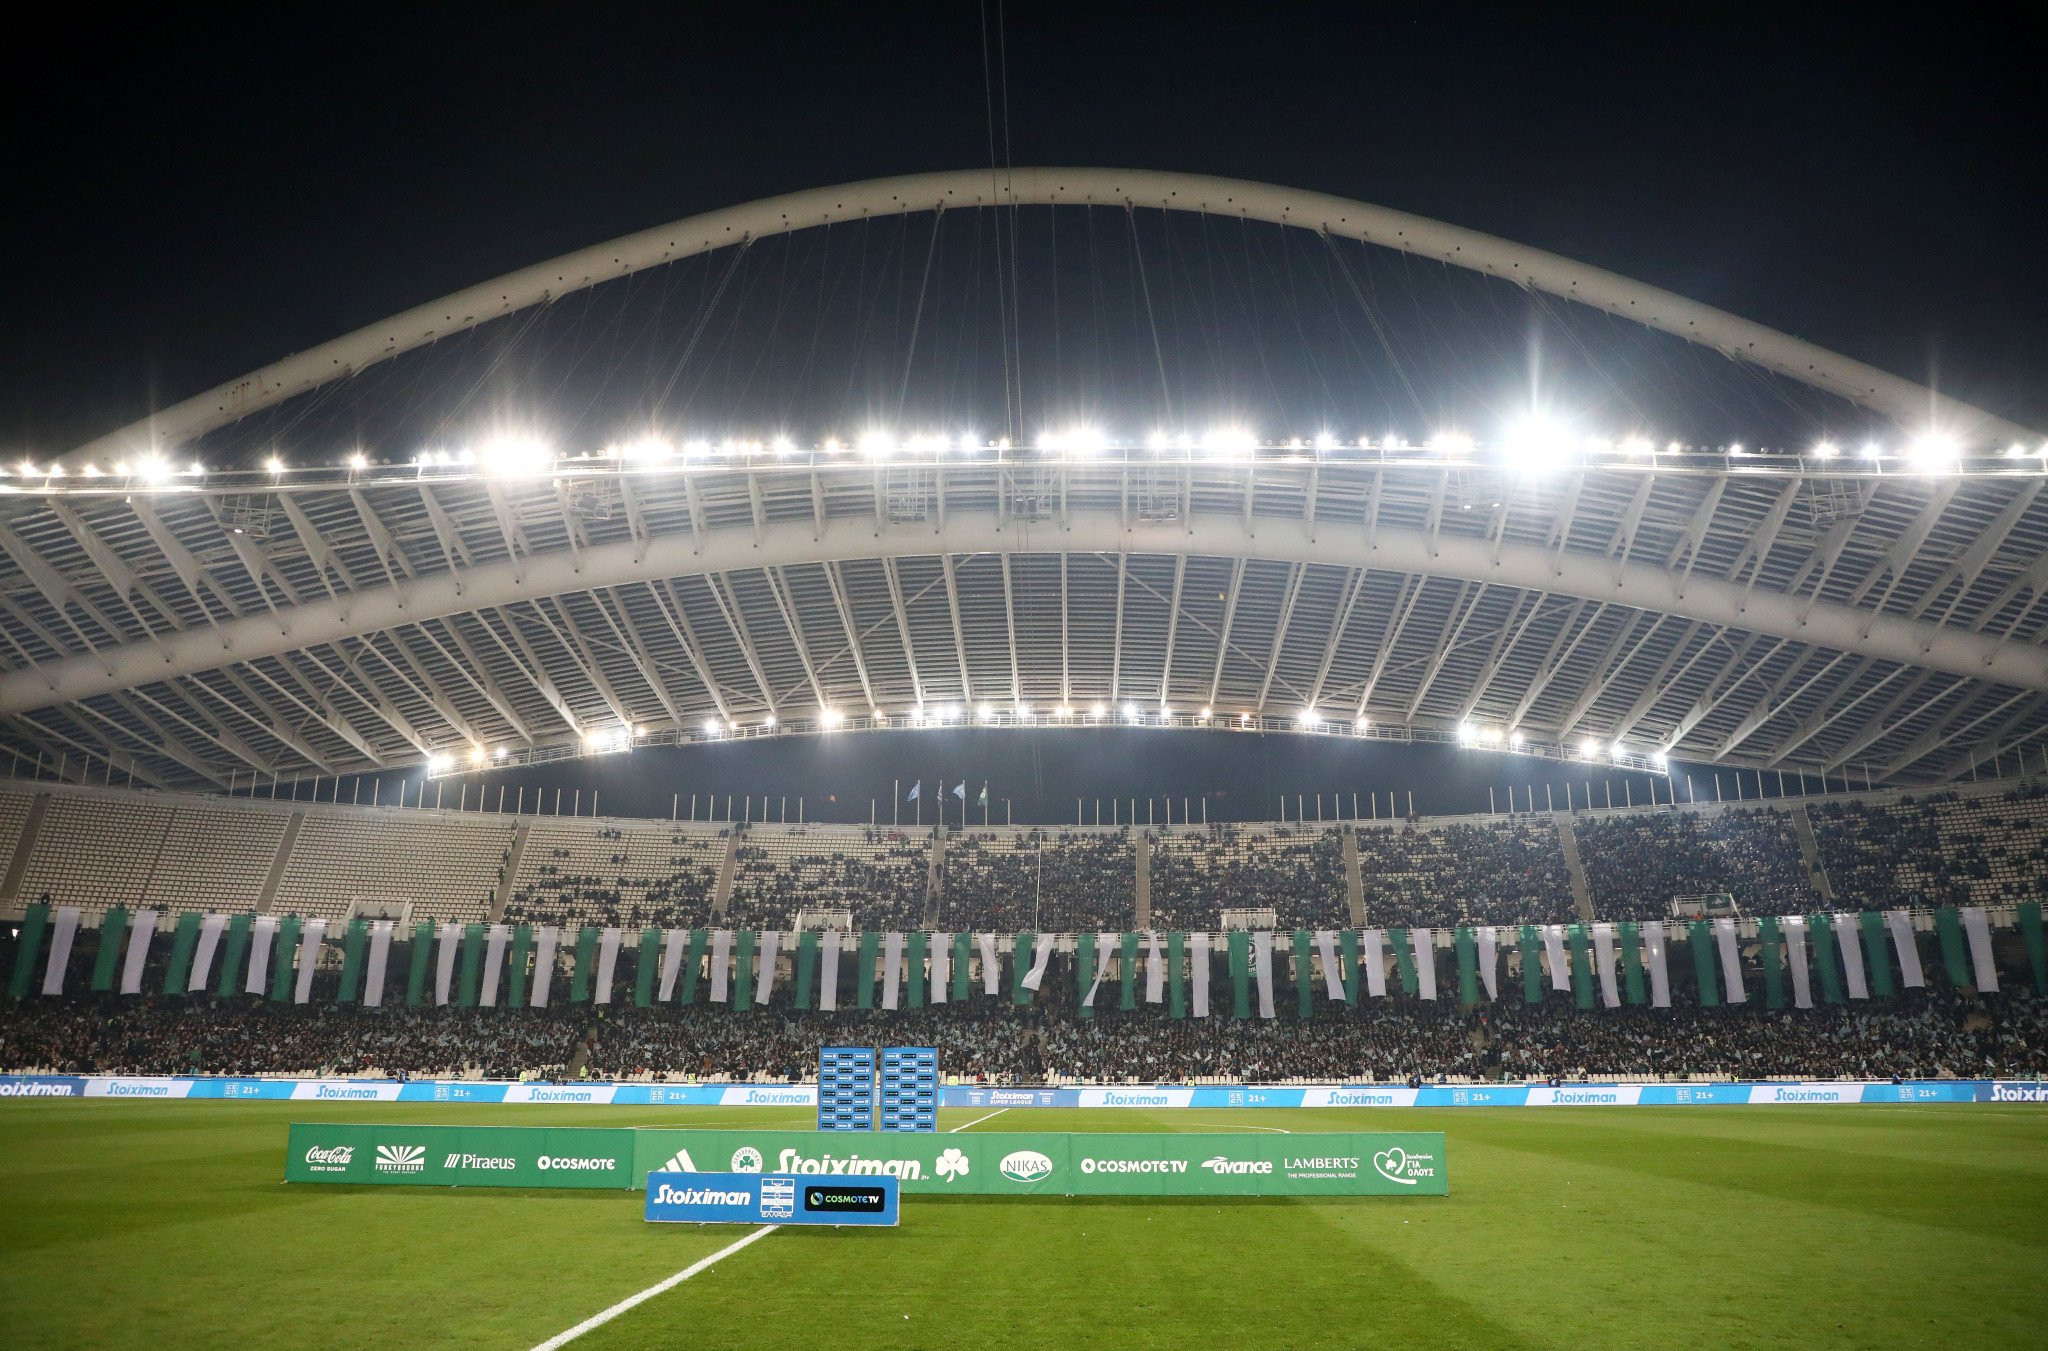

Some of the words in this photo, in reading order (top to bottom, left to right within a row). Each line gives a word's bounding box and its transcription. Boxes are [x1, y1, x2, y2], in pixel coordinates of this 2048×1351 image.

[0, 1082, 72, 1096] oiximan
[106, 1082, 168, 1096] Stoiximan
[243, 1086, 260, 1094] 21+
[316, 1085, 378, 1099] Stoiximan
[453, 1089, 471, 1097] 21+
[528, 1088, 592, 1102] Stoiximan
[990, 1091, 1034, 1100] Stoiximan
[1696, 1091, 1714, 1099] 21+
[1774, 1088, 1839, 1101] Stoiximan
[1919, 1089, 1937, 1097] 21+
[668, 1092, 687, 1100] 21+
[745, 1090, 811, 1104] Stoiximan
[1102, 1091, 1168, 1105] Stoiximan
[1249, 1094, 1267, 1102] 21+
[1327, 1091, 1393, 1105] Stoiximan
[1473, 1093, 1491, 1101] 21+
[1551, 1089, 1617, 1103] Stoiximan
[305, 1145, 355, 1164] Coca-Cola
[461, 1153, 516, 1170] Piraeus
[551, 1158, 616, 1170] COSMOTE
[773, 1148, 921, 1180] Stoiximan
[1006, 1160, 1047, 1172] NIKAS
[1097, 1160, 1169, 1173] COSMOTE
[1169, 1160, 1188, 1173] TV
[1213, 1160, 1273, 1174] avance
[1284, 1157, 1359, 1169] LAMBERTS
[1407, 1160, 1421, 1169] ΓΙΑ
[1407, 1168, 1434, 1177] ΟΛΟΥΣ
[653, 1184, 751, 1206] Stoiximan
